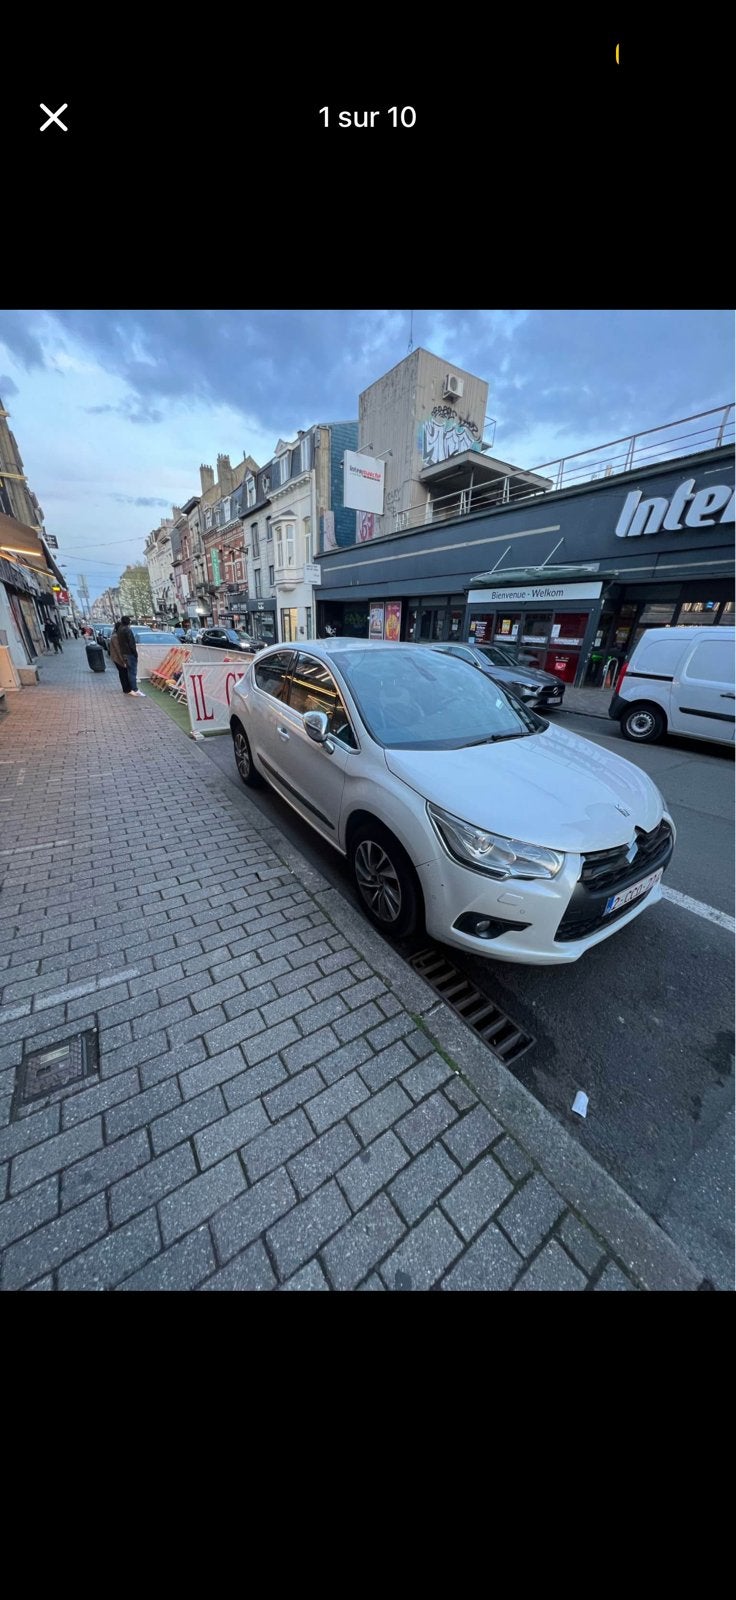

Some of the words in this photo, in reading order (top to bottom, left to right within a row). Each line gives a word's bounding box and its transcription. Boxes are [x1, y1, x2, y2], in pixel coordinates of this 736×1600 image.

[491, 591, 526, 600] Bienvenue
[531, 588, 564, 598] Welkom
[189, 674, 214, 721] IL
